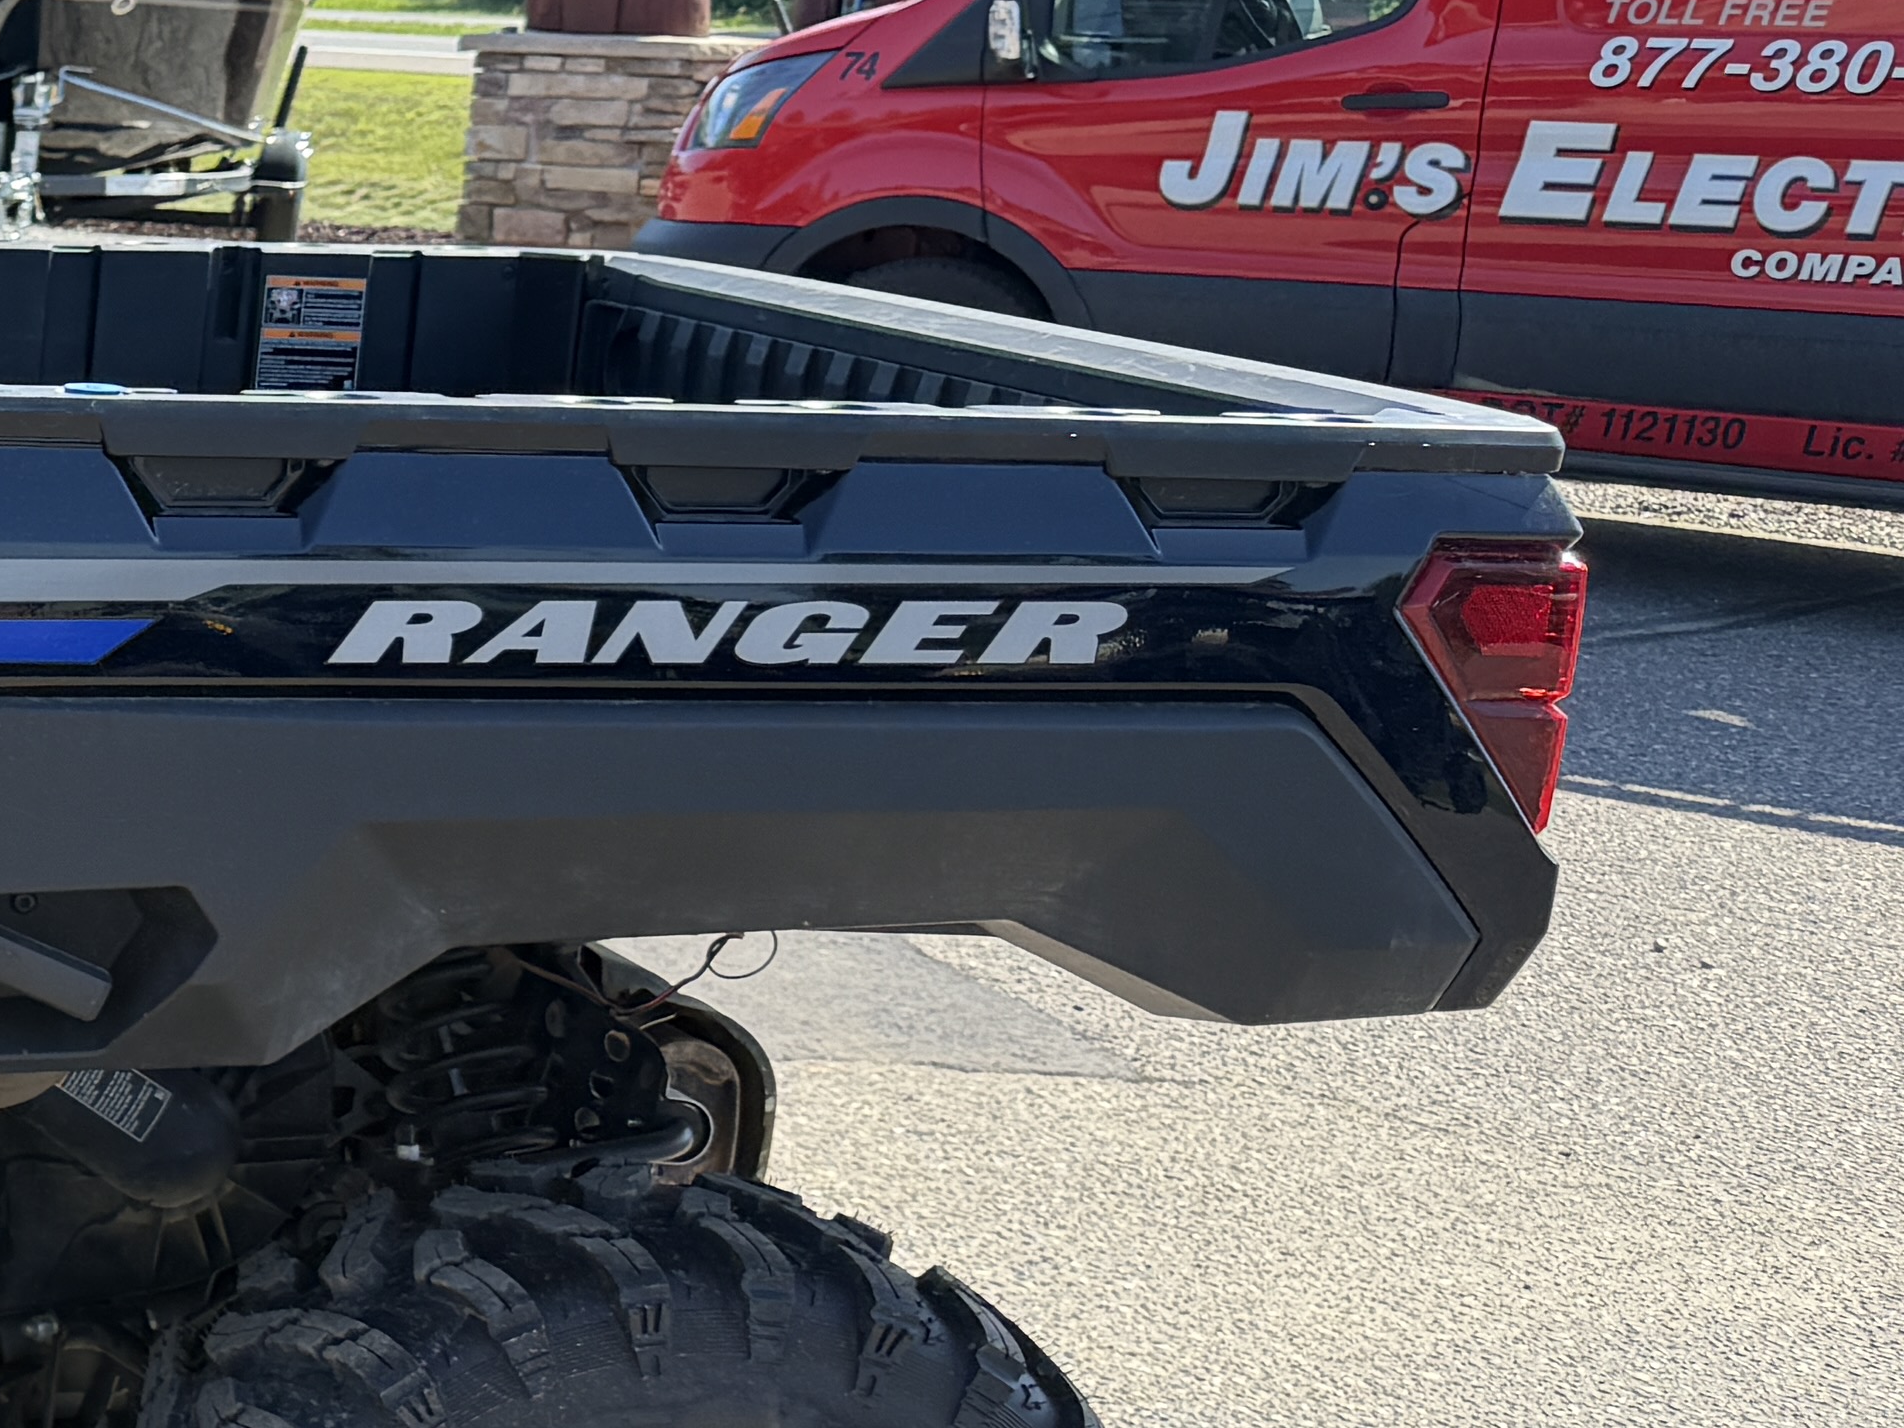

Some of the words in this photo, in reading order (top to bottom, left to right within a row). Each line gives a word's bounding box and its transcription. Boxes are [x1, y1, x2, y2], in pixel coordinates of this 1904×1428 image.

[838, 51, 881, 82] 74
[1158, 109, 1469, 219] JIM'S
[1729, 249, 1903, 288] COMPA
[1599, 408, 1747, 449] 1121130
[1802, 424, 1874, 461] Lic.
[326, 600, 1128, 665] RANGER
